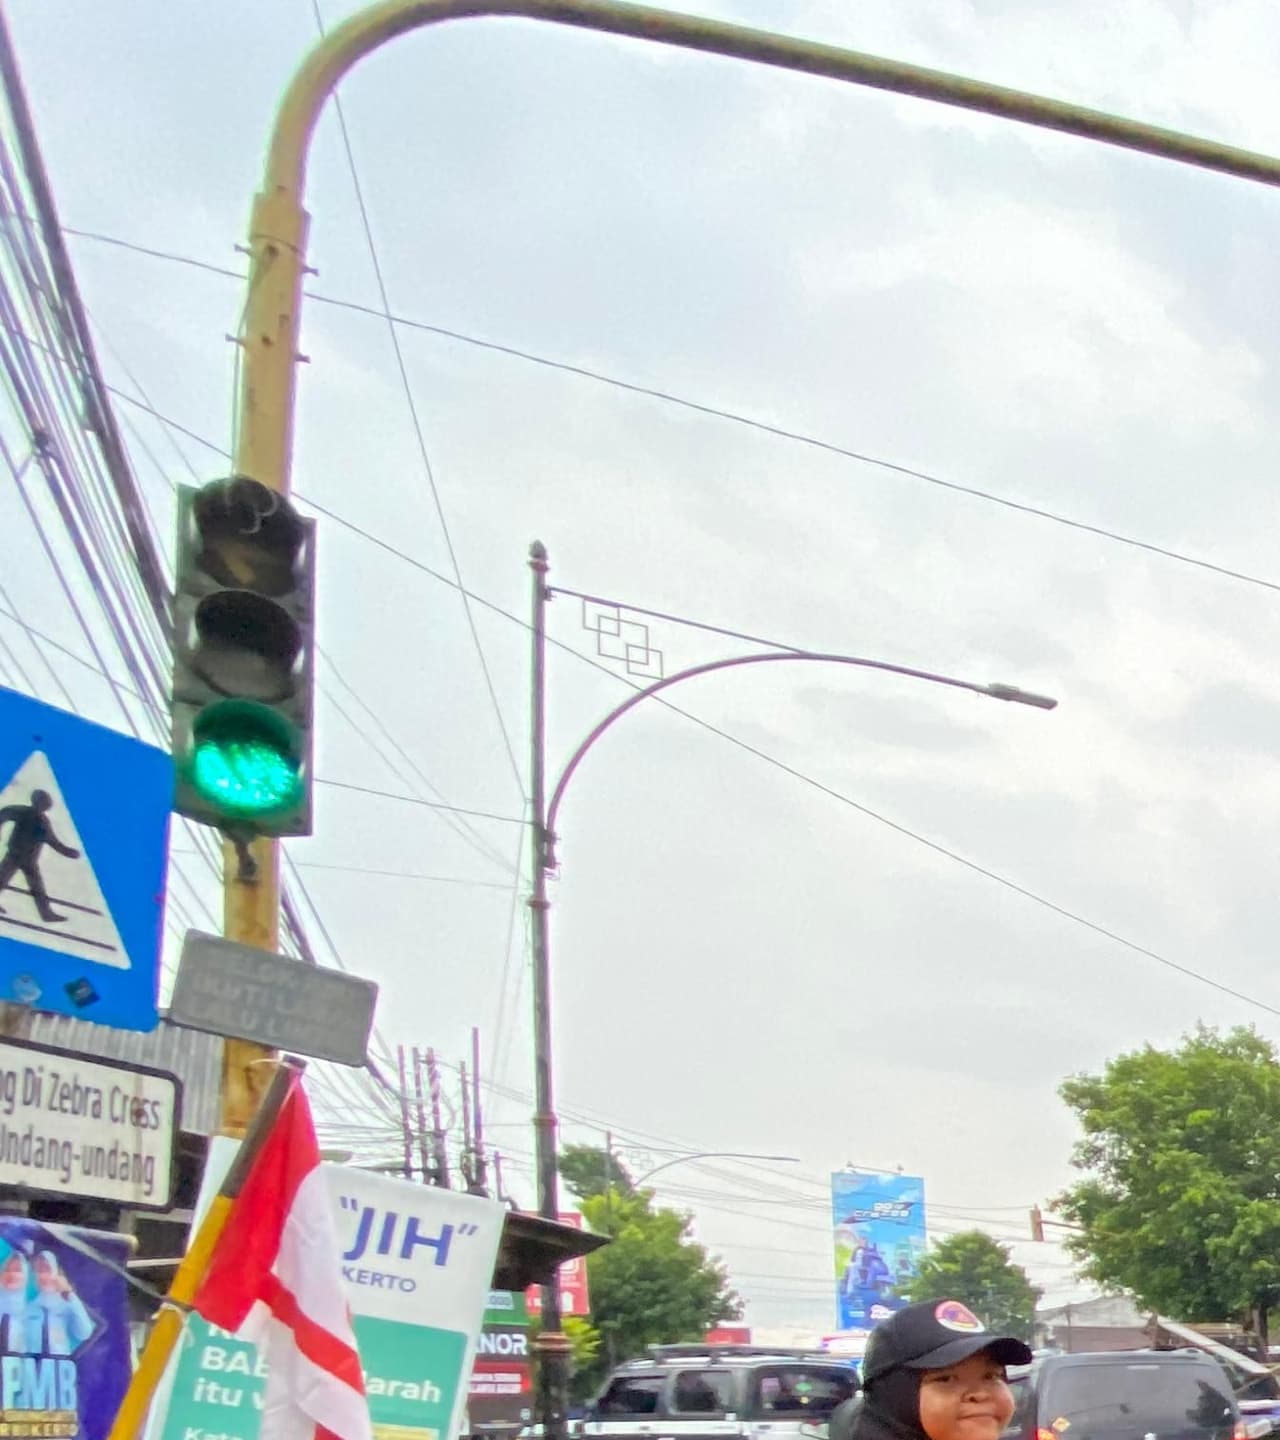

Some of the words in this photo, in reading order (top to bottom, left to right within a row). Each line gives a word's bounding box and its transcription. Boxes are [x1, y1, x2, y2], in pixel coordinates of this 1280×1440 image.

[22, 1065, 43, 1108] Di
[47, 1072, 103, 1119] Zebra
[109, 1085, 161, 1130] Cross
[342, 1266, 417, 1293] KERTO
[474, 1332, 528, 1356] NOR
[194, 1377, 243, 1408] itu
[363, 1371, 442, 1403] arah
